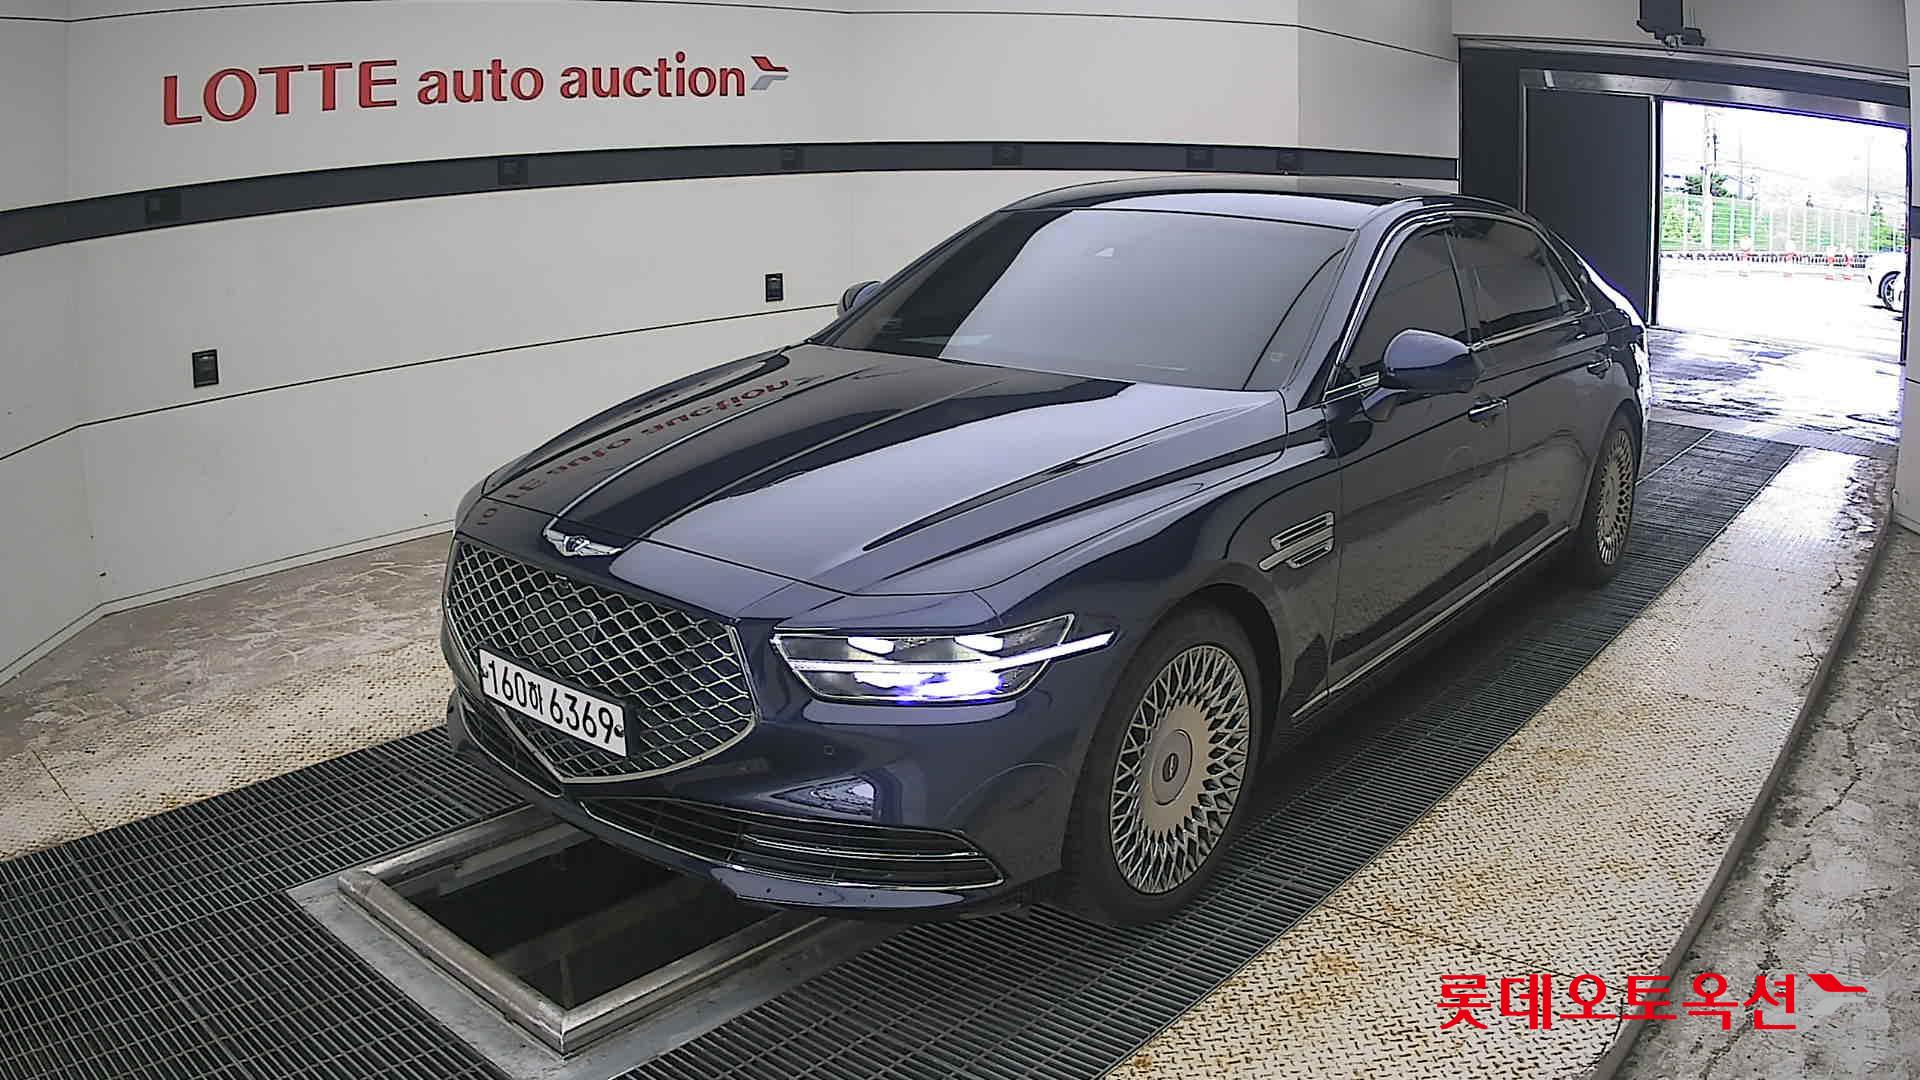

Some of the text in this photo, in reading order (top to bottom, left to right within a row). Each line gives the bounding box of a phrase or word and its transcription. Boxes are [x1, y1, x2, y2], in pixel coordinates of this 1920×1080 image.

[162, 51, 748, 126] LOTTE auto auction
[487, 660, 614, 745] 160하 6369
